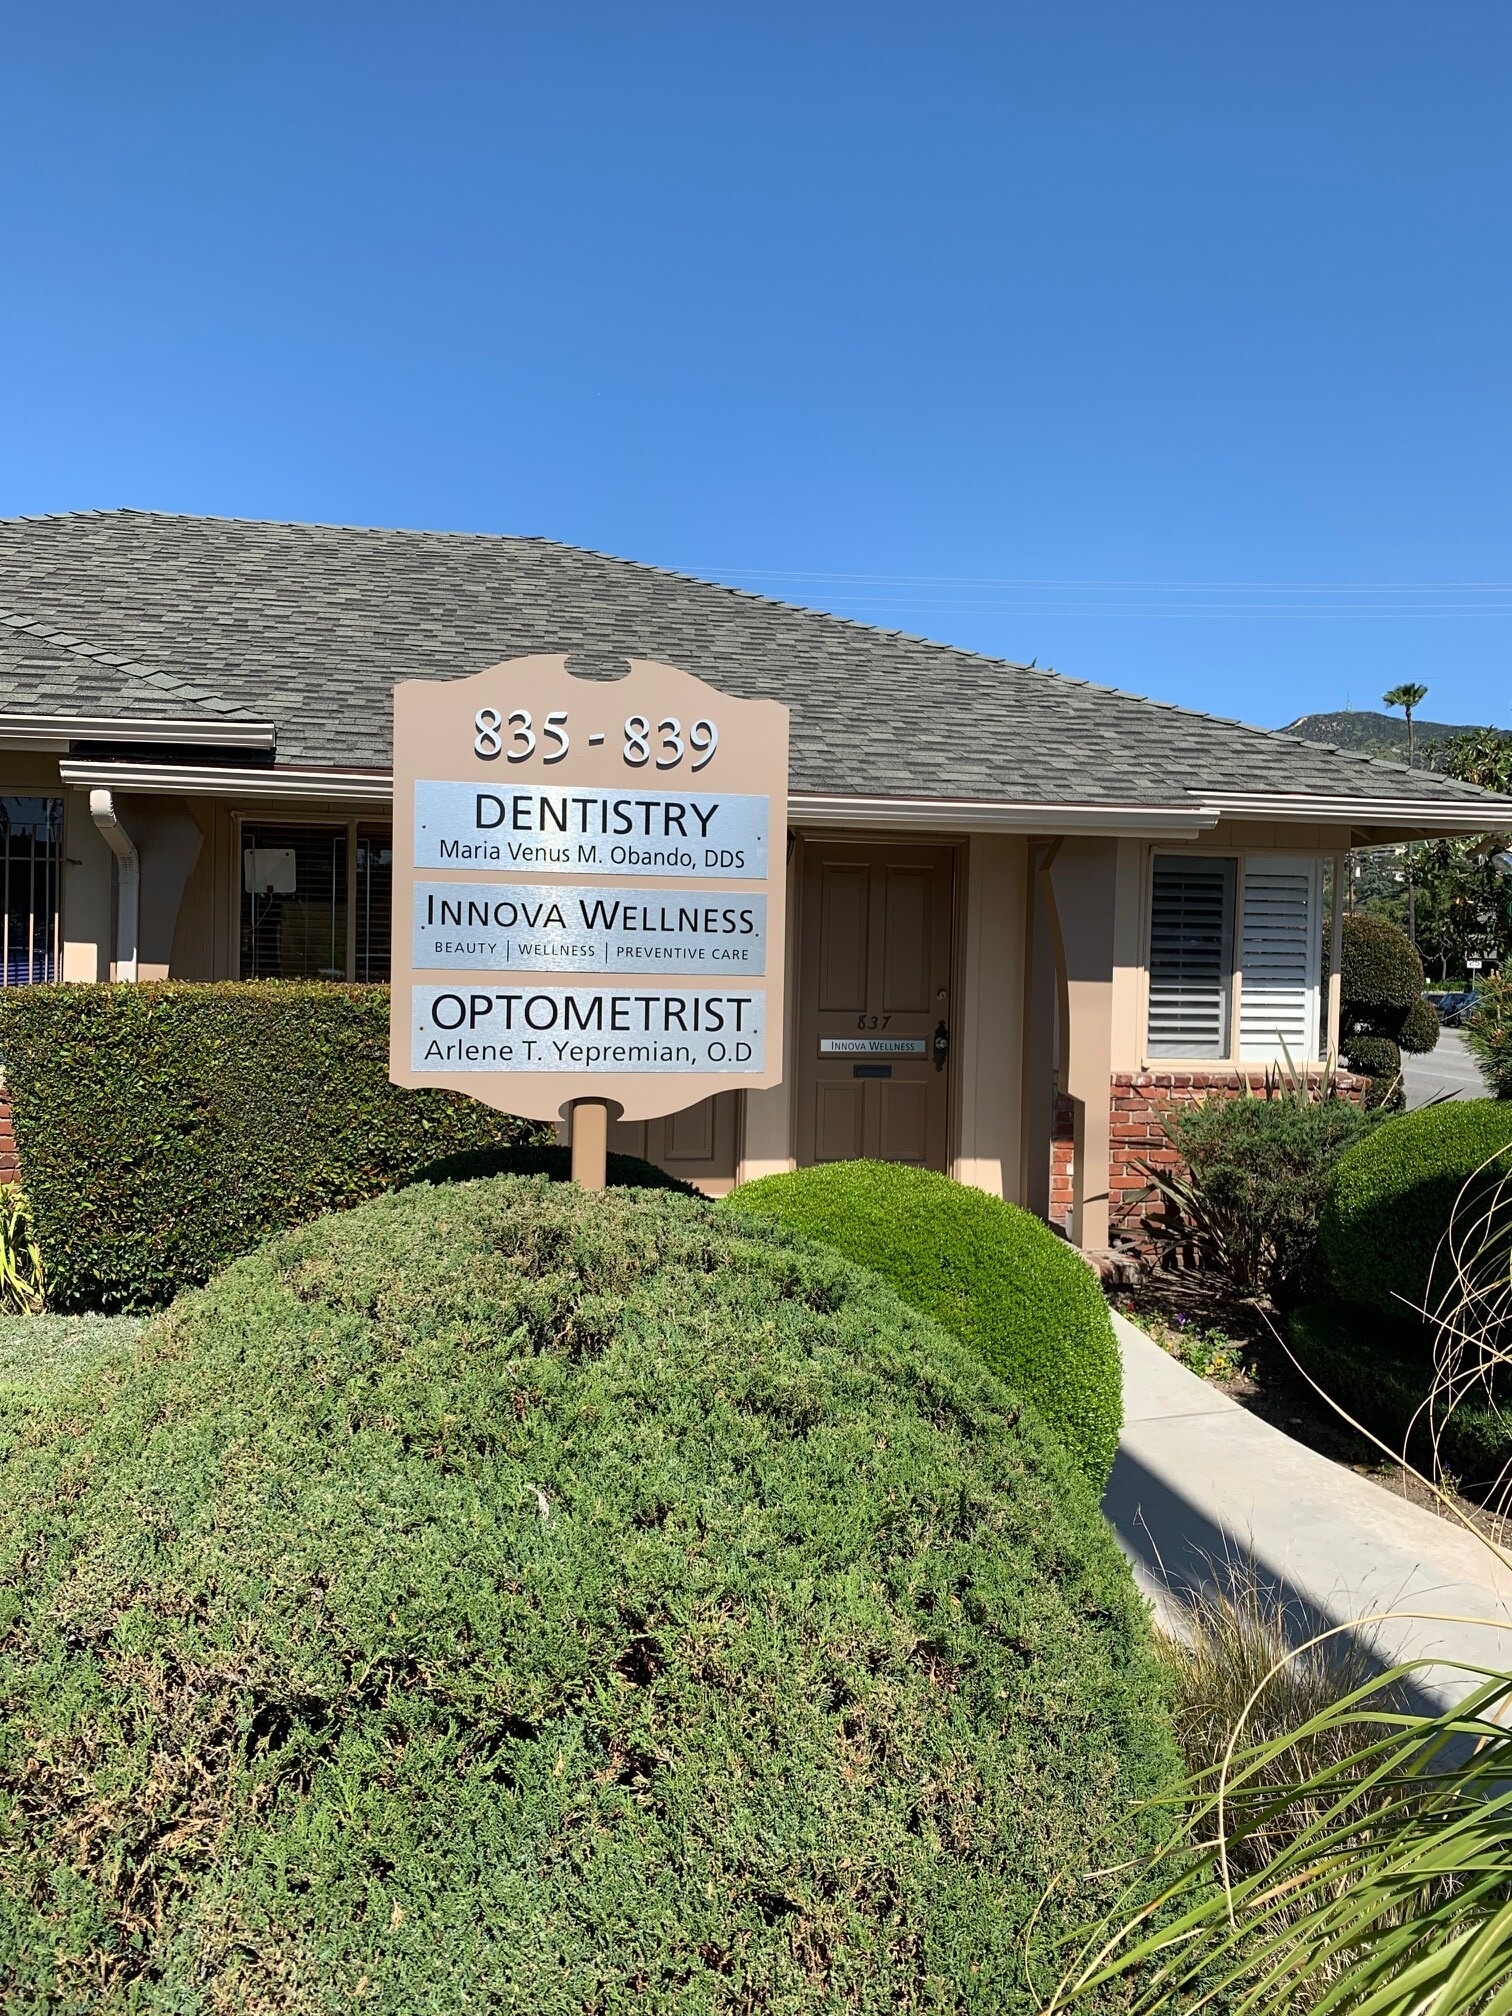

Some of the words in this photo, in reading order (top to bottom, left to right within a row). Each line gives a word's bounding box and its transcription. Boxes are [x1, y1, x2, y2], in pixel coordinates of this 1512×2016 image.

[474, 707, 570, 764] 835
[623, 715, 719, 772] 839
[475, 793, 719, 837] DENTISTRY
[440, 839, 500, 860] Maria
[507, 842, 570, 863] Venus
[577, 845, 603, 863] M.
[610, 846, 696, 870] Obando,
[704, 849, 745, 868] DDS
[427, 894, 567, 929] INNOVA
[579, 900, 754, 934] WELLNESS
[434, 941, 497, 954] BEAUTY
[518, 944, 595, 957] WELLNESS
[616, 946, 705, 960] PREVENTIVE
[711, 948, 749, 961] CARE
[431, 994, 752, 1032] OPTOMETRIST
[857, 1014, 891, 1030] 837
[424, 1040, 513, 1061] Arlene
[521, 1041, 542, 1061] T.
[552, 1041, 697, 1067] Yepremian,
[707, 1042, 752, 1062] O.D
[831, 1041, 866, 1050] INNOVA
[868, 1041, 915, 1051] WELLNESS
